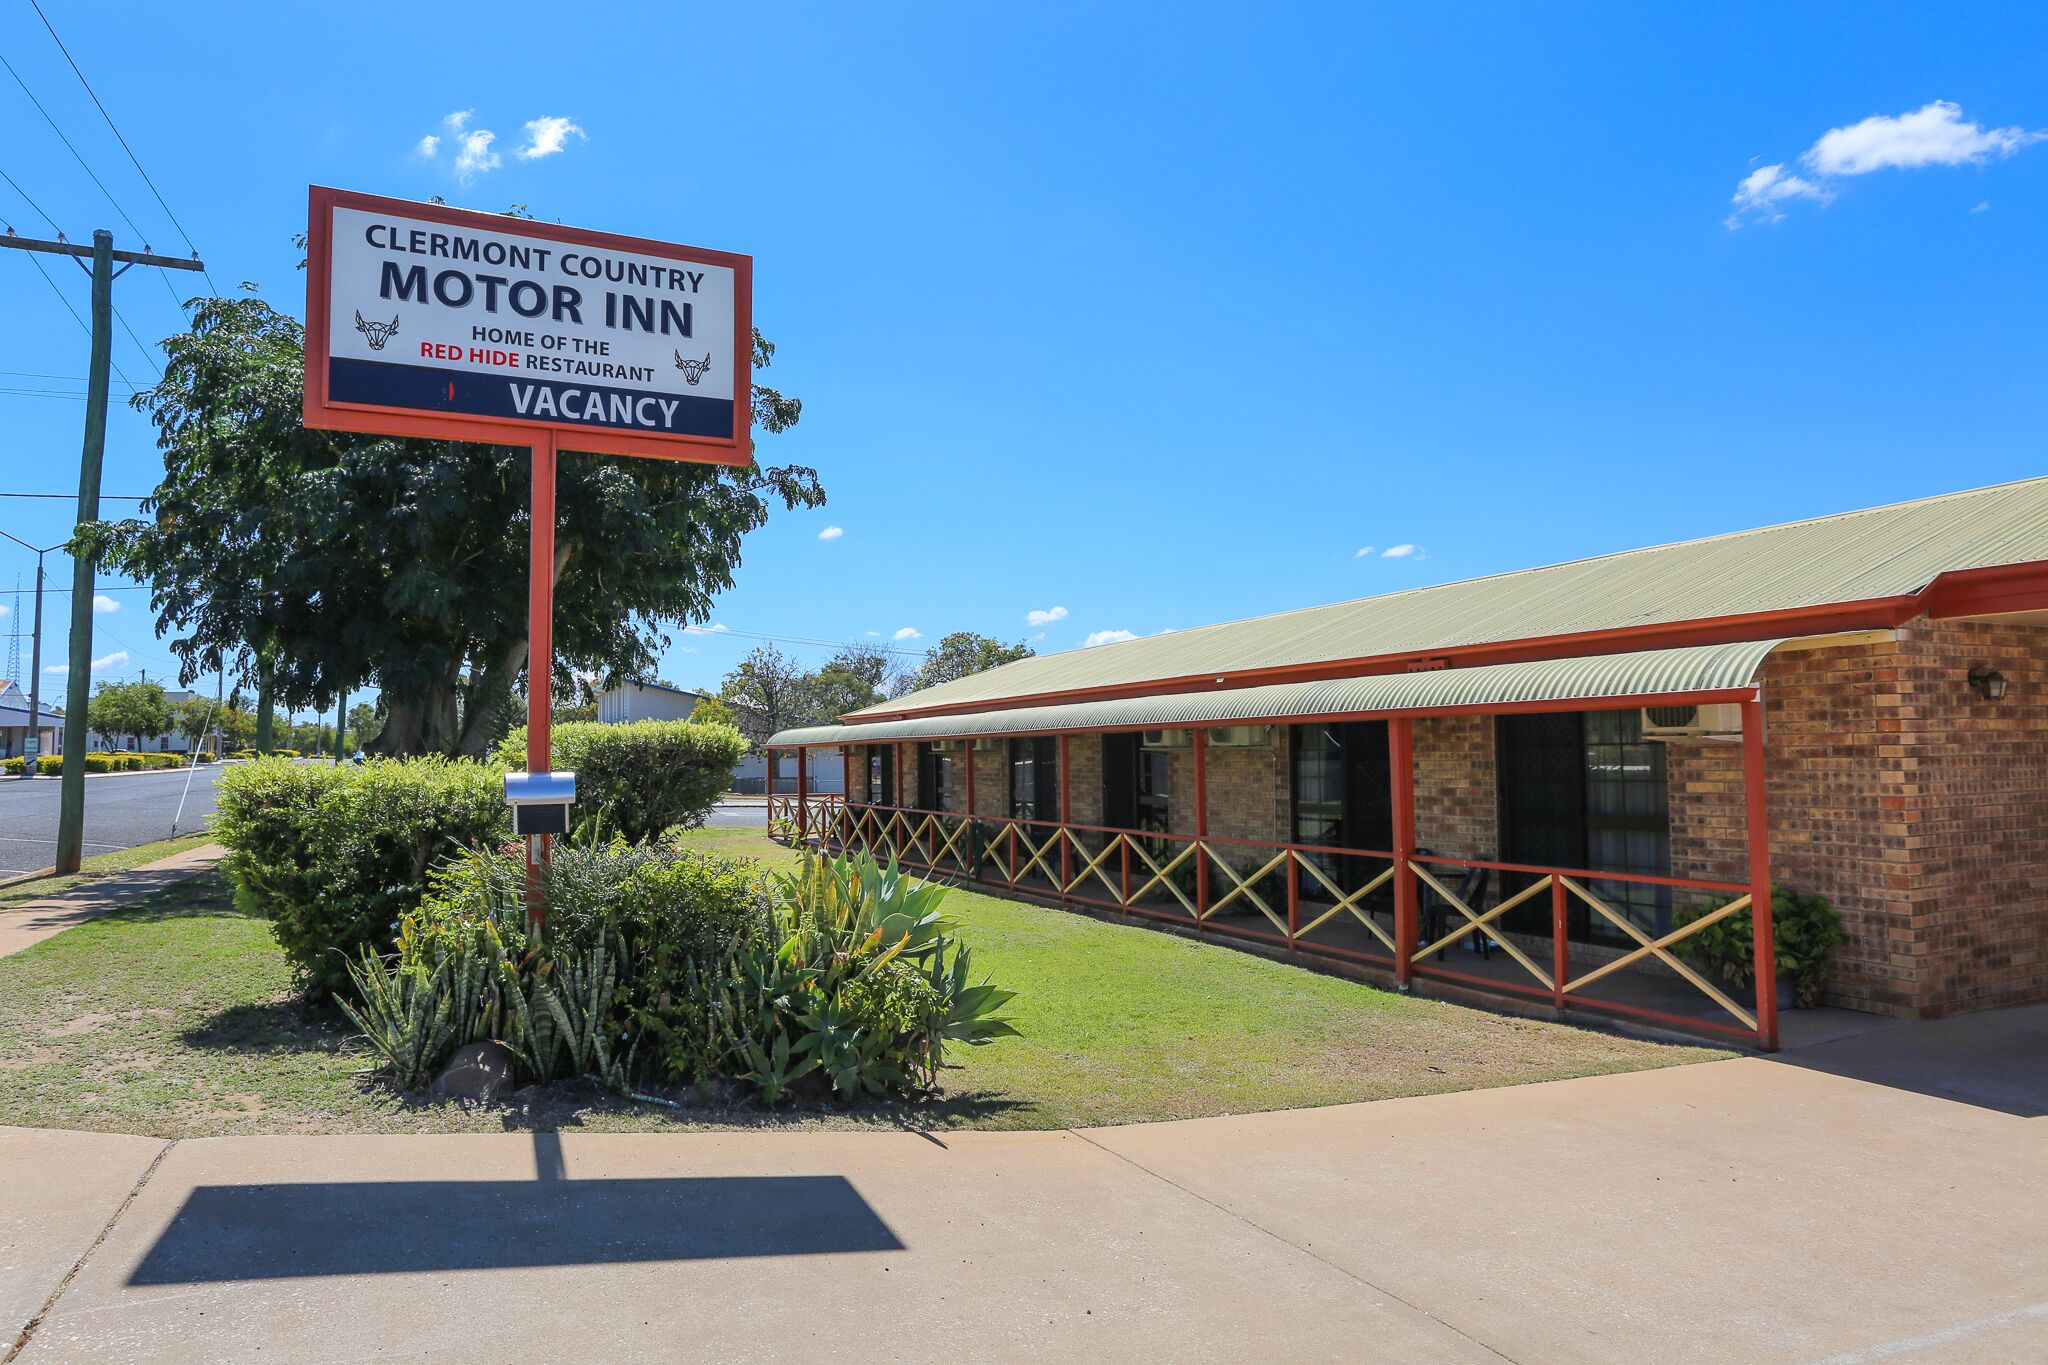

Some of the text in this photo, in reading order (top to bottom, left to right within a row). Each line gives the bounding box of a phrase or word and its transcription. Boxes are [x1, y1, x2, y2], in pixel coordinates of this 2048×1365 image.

[365, 224, 705, 293] CLERMONT COUNTRY
[379, 261, 693, 339] MOTOR INN
[420, 342, 655, 382] RED HIDE RESTAURANT
[472, 325, 610, 356] HOME OF THE
[509, 383, 679, 428] VACANCY
